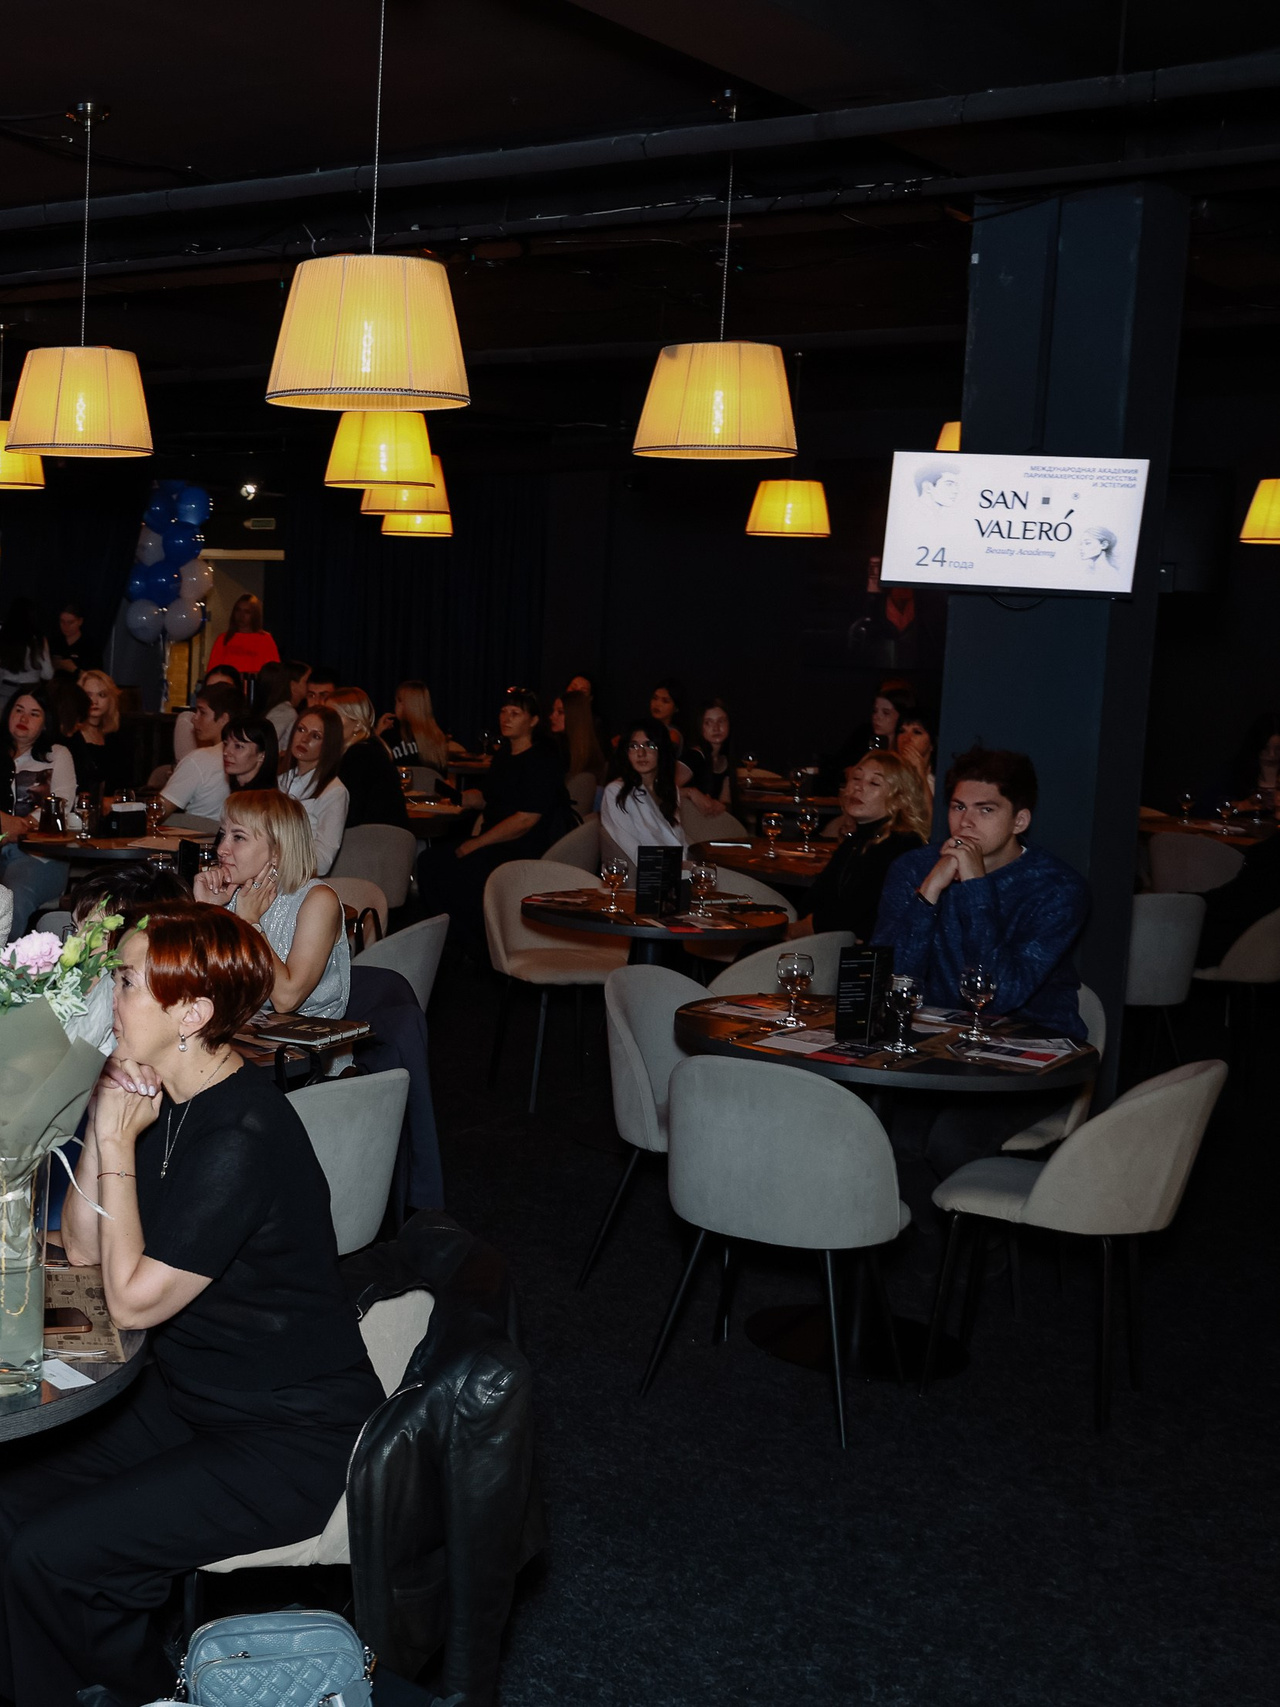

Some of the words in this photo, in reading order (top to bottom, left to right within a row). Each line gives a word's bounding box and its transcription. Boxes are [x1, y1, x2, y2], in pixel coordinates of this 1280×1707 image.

[1024, 472, 1094, 481] ПАРИКМАХЕРСКОГО
[1030, 465, 1096, 473] МЕЖДУНАРОДНАЯ
[1098, 467, 1139, 475] АКАДЕМИЯ
[978, 489, 1029, 510] SAN
[974, 509, 1073, 542] VALERÓ
[915, 546, 947, 567] 24
[948, 559, 974, 570] года
[985, 546, 1015, 556] Beauty
[1017, 547, 1055, 558] Academy
